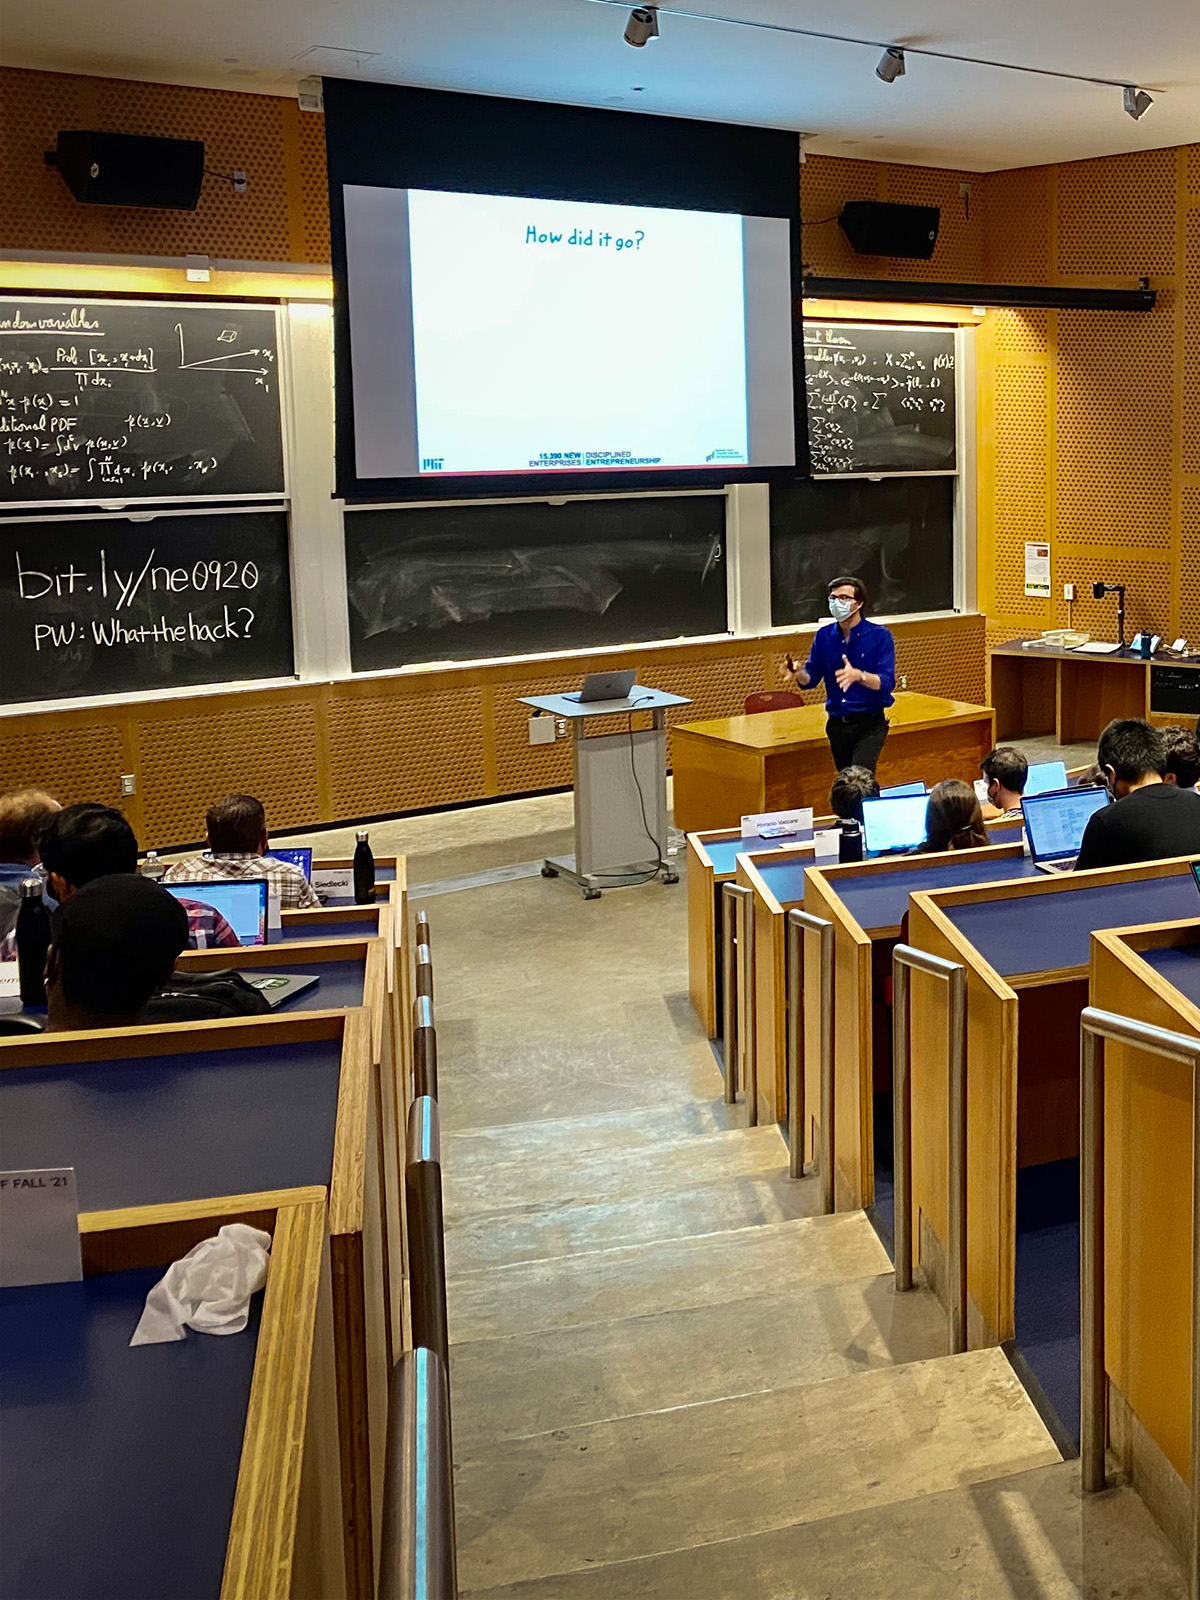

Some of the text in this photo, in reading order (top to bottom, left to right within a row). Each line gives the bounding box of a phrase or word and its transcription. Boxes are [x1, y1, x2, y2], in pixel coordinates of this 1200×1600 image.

[526, 226, 645, 251] How did it go?
[50, 417, 77, 432] PDF
[564, 451, 581, 459] NEW
[585, 451, 632, 459] DISCIPLINED
[585, 457, 661, 466] ENTREPRENEURSHIP
[529, 459, 582, 467] ENTERPRISES
[16, 548, 259, 610] bit.ly/ne0920
[35, 621, 85, 650] PW:
[13, 1178, 47, 1189] FALL
[50, 1176, 67, 1187] '21
